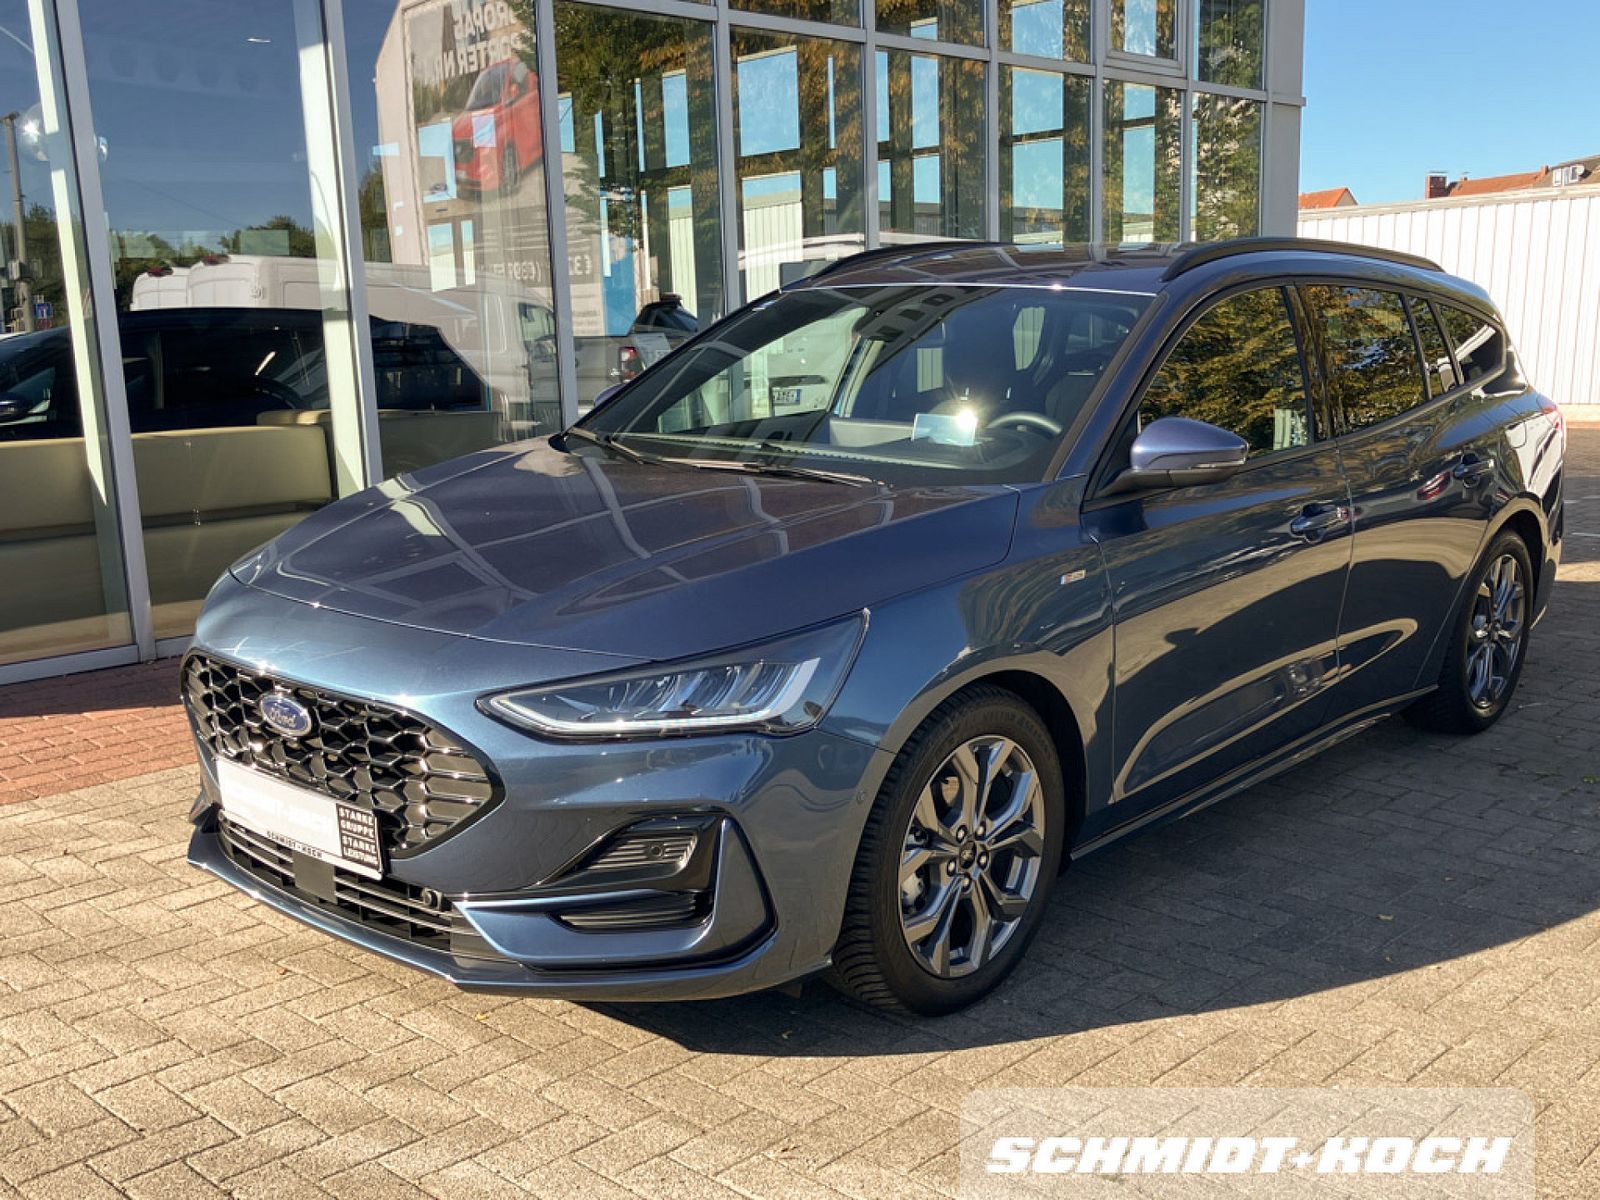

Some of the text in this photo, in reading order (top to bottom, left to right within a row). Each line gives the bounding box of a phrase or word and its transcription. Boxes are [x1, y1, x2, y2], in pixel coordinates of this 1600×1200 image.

[269, 702, 298, 728] Ford
[339, 807, 374, 827] STARKE
[340, 819, 375, 839] GRUPPE
[342, 835, 377, 855] STARKE
